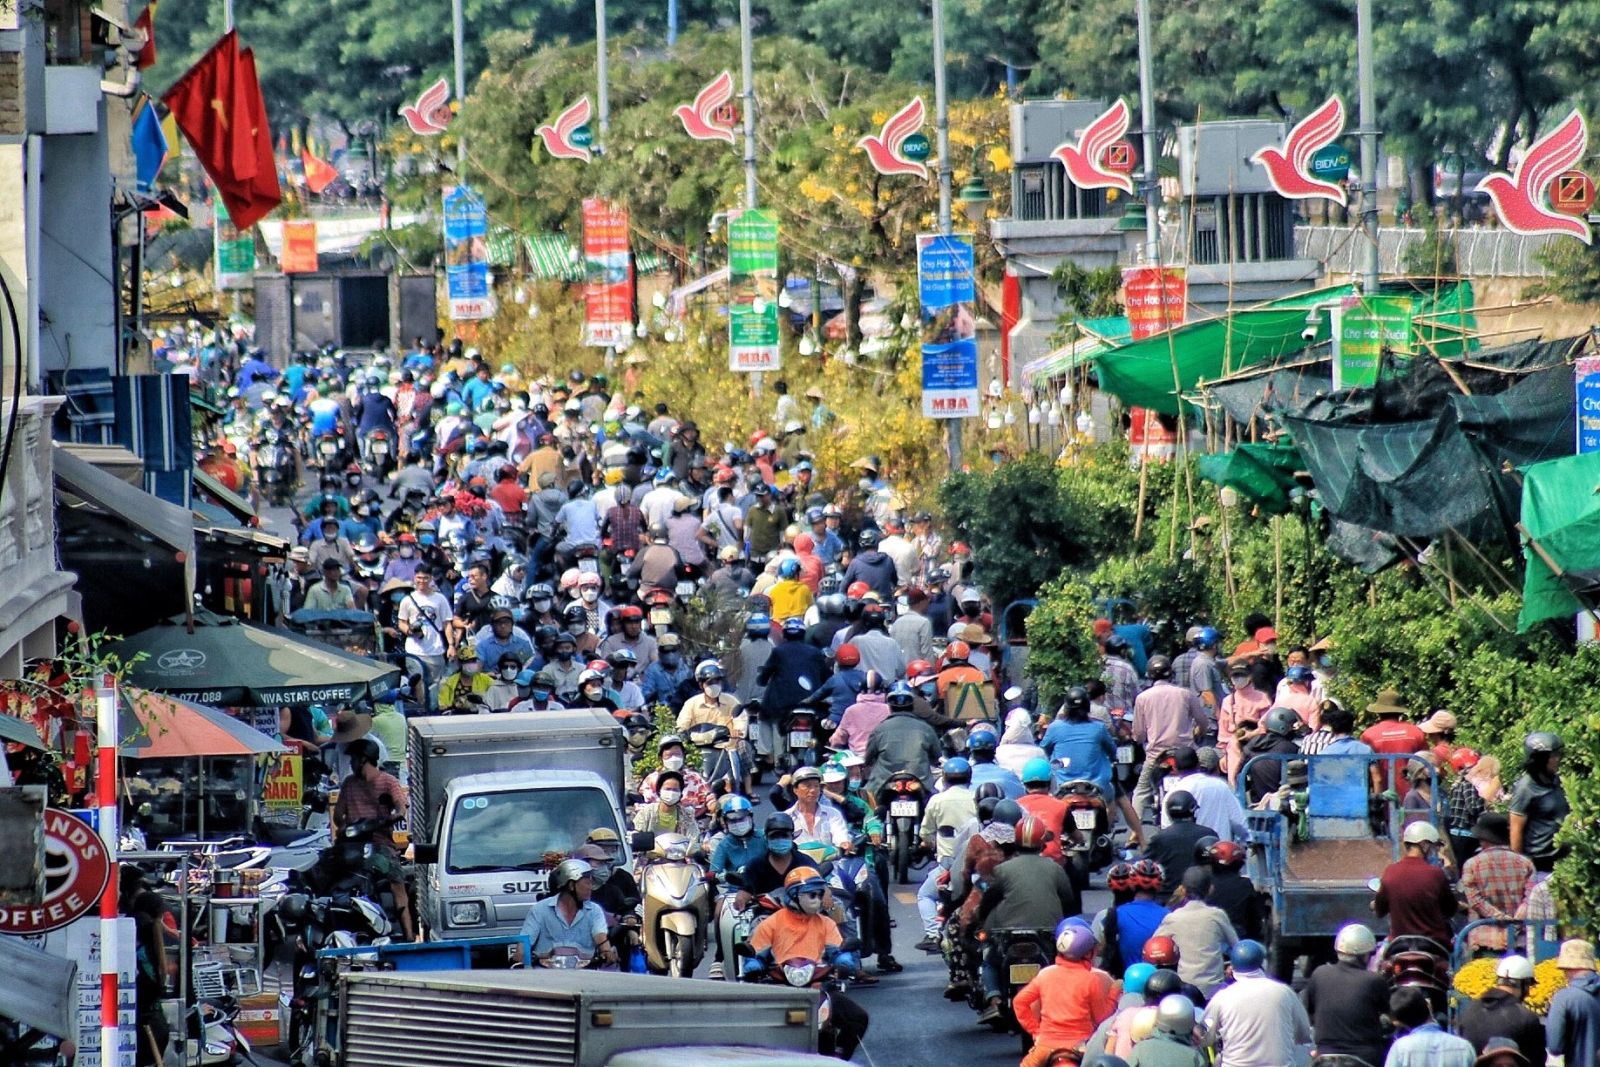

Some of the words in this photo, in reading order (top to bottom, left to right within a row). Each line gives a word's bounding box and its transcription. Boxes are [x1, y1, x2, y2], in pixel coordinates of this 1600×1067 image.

[1315, 156, 1338, 170] BIDV
[931, 396, 969, 409] MBA
[260, 692, 283, 704] VIVA
[283, 690, 310, 703] STAR
[311, 687, 352, 701] COFFEE
